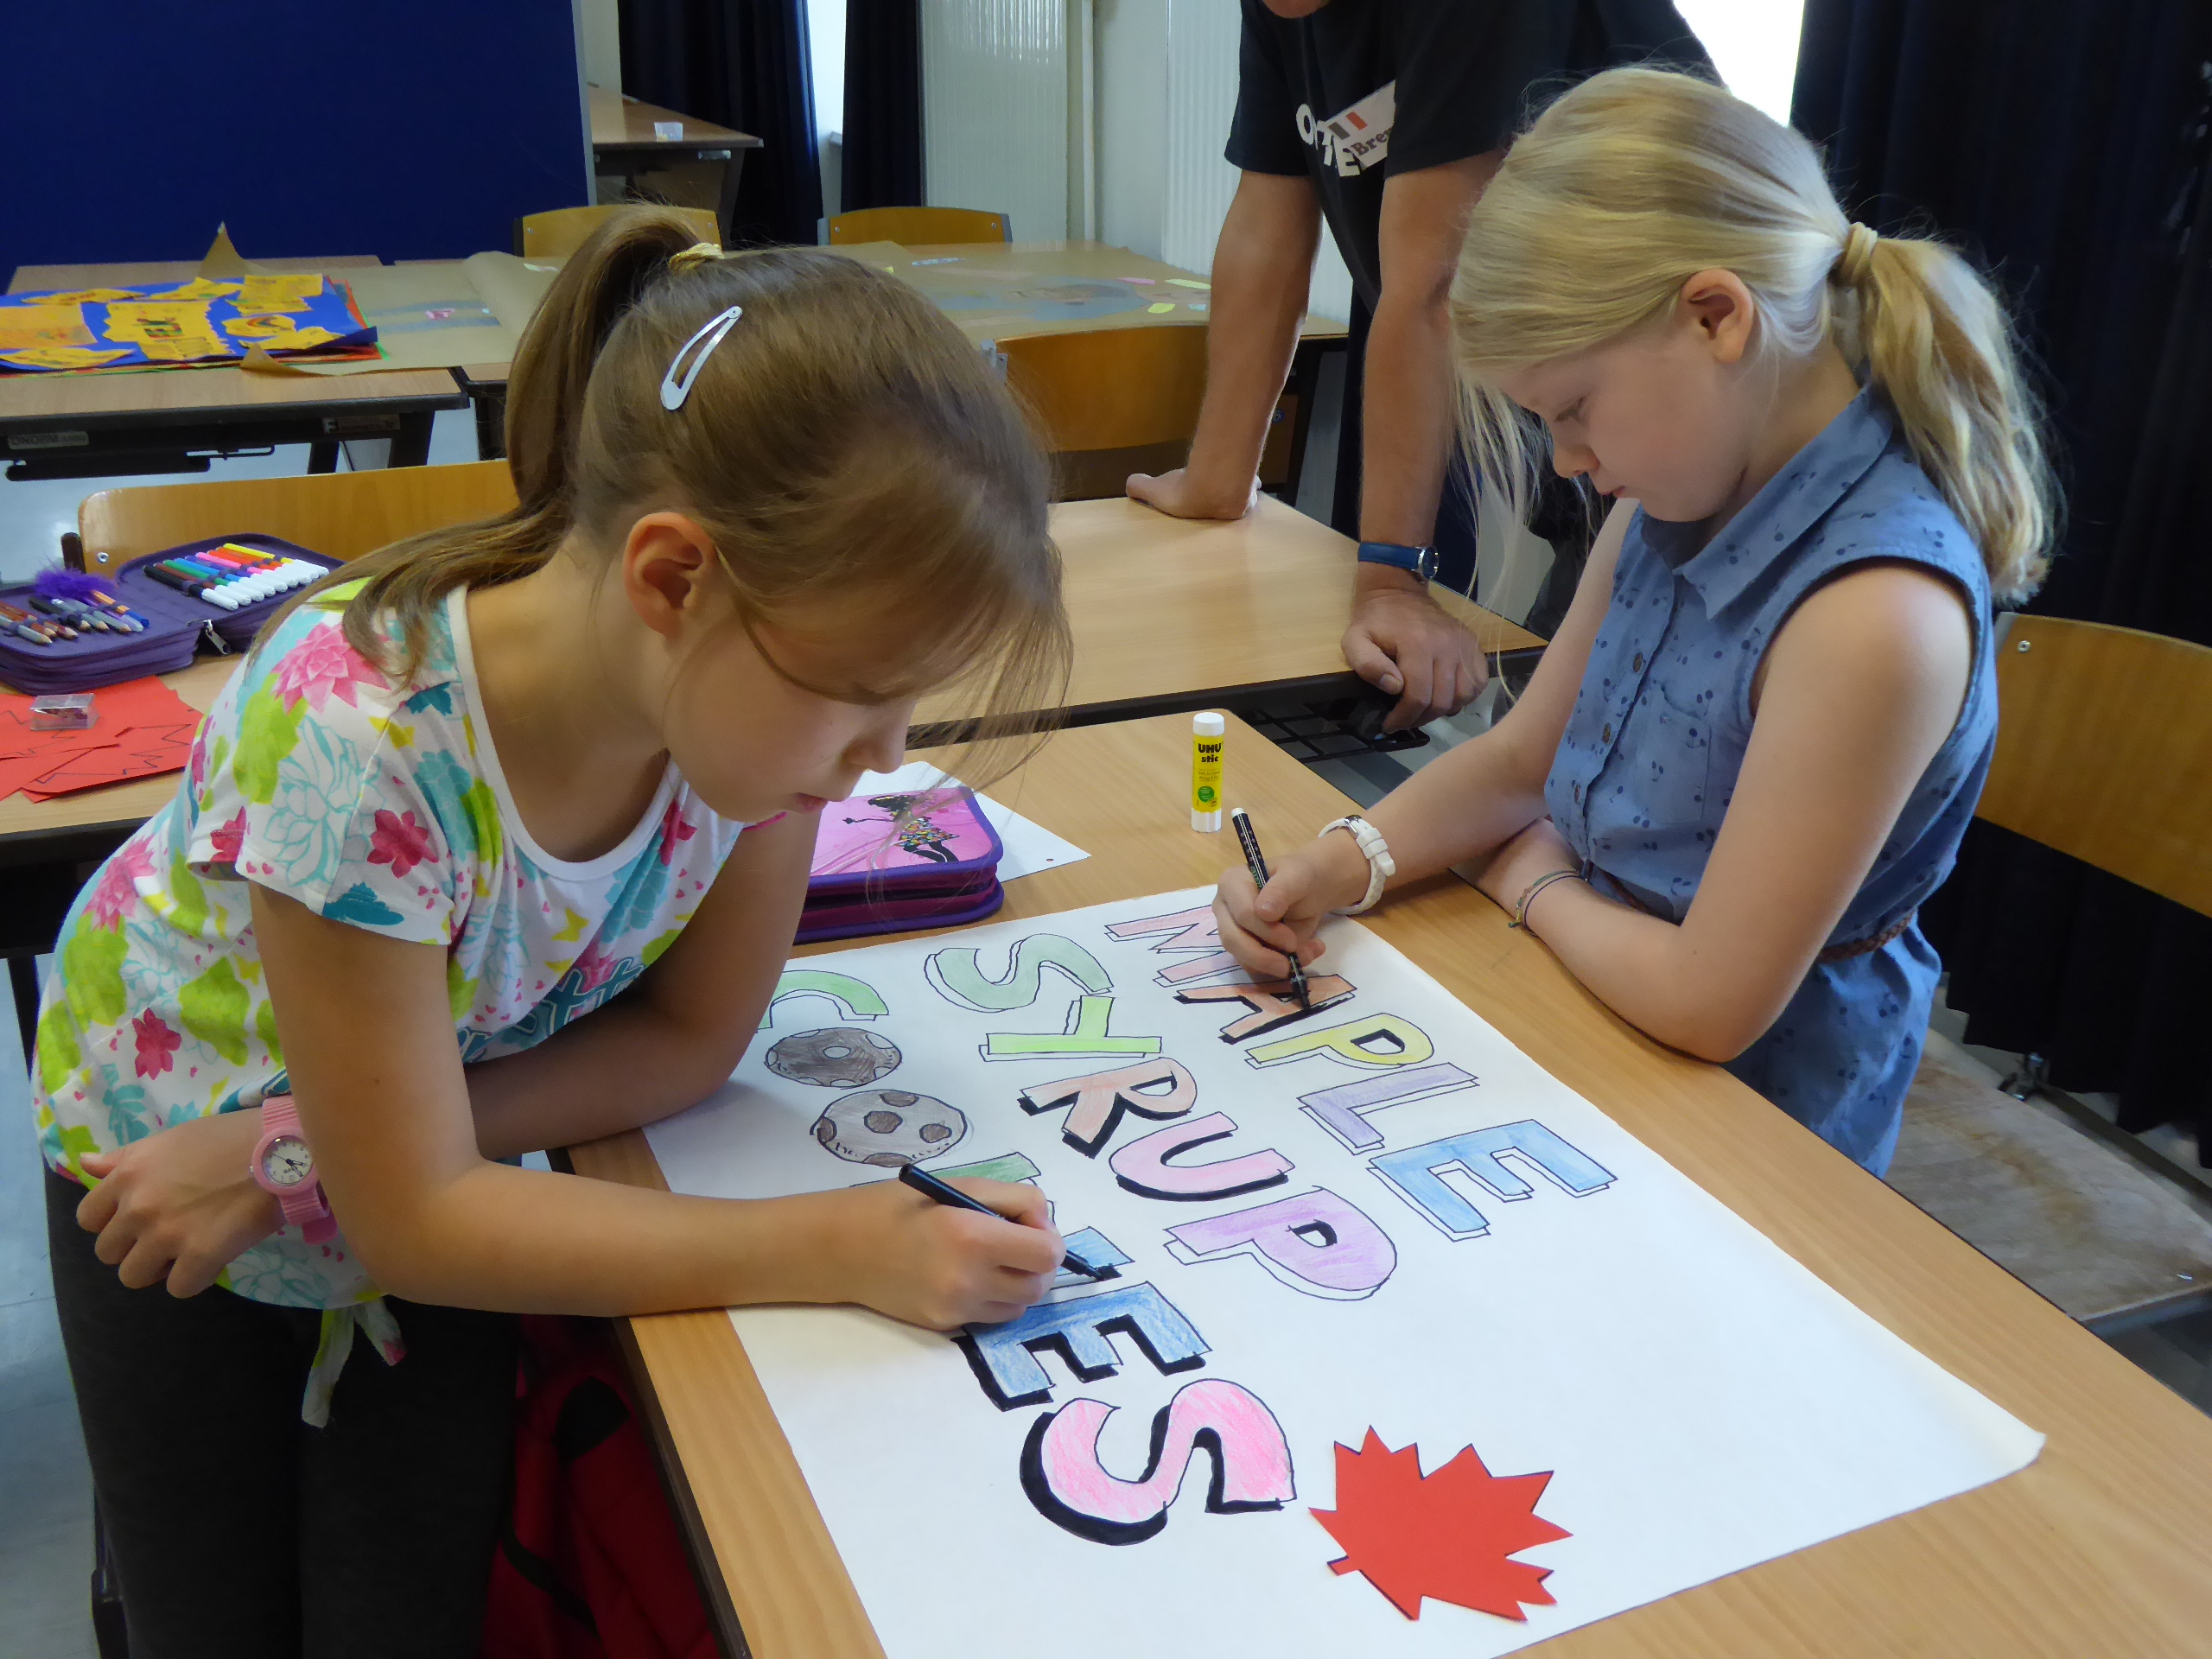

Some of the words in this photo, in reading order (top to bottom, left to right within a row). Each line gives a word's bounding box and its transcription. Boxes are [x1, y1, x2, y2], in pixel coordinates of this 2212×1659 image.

[1198, 743, 1222, 753] UHU
[1200, 753, 1219, 763] stic
[925, 933, 1398, 1302] SYRUP
